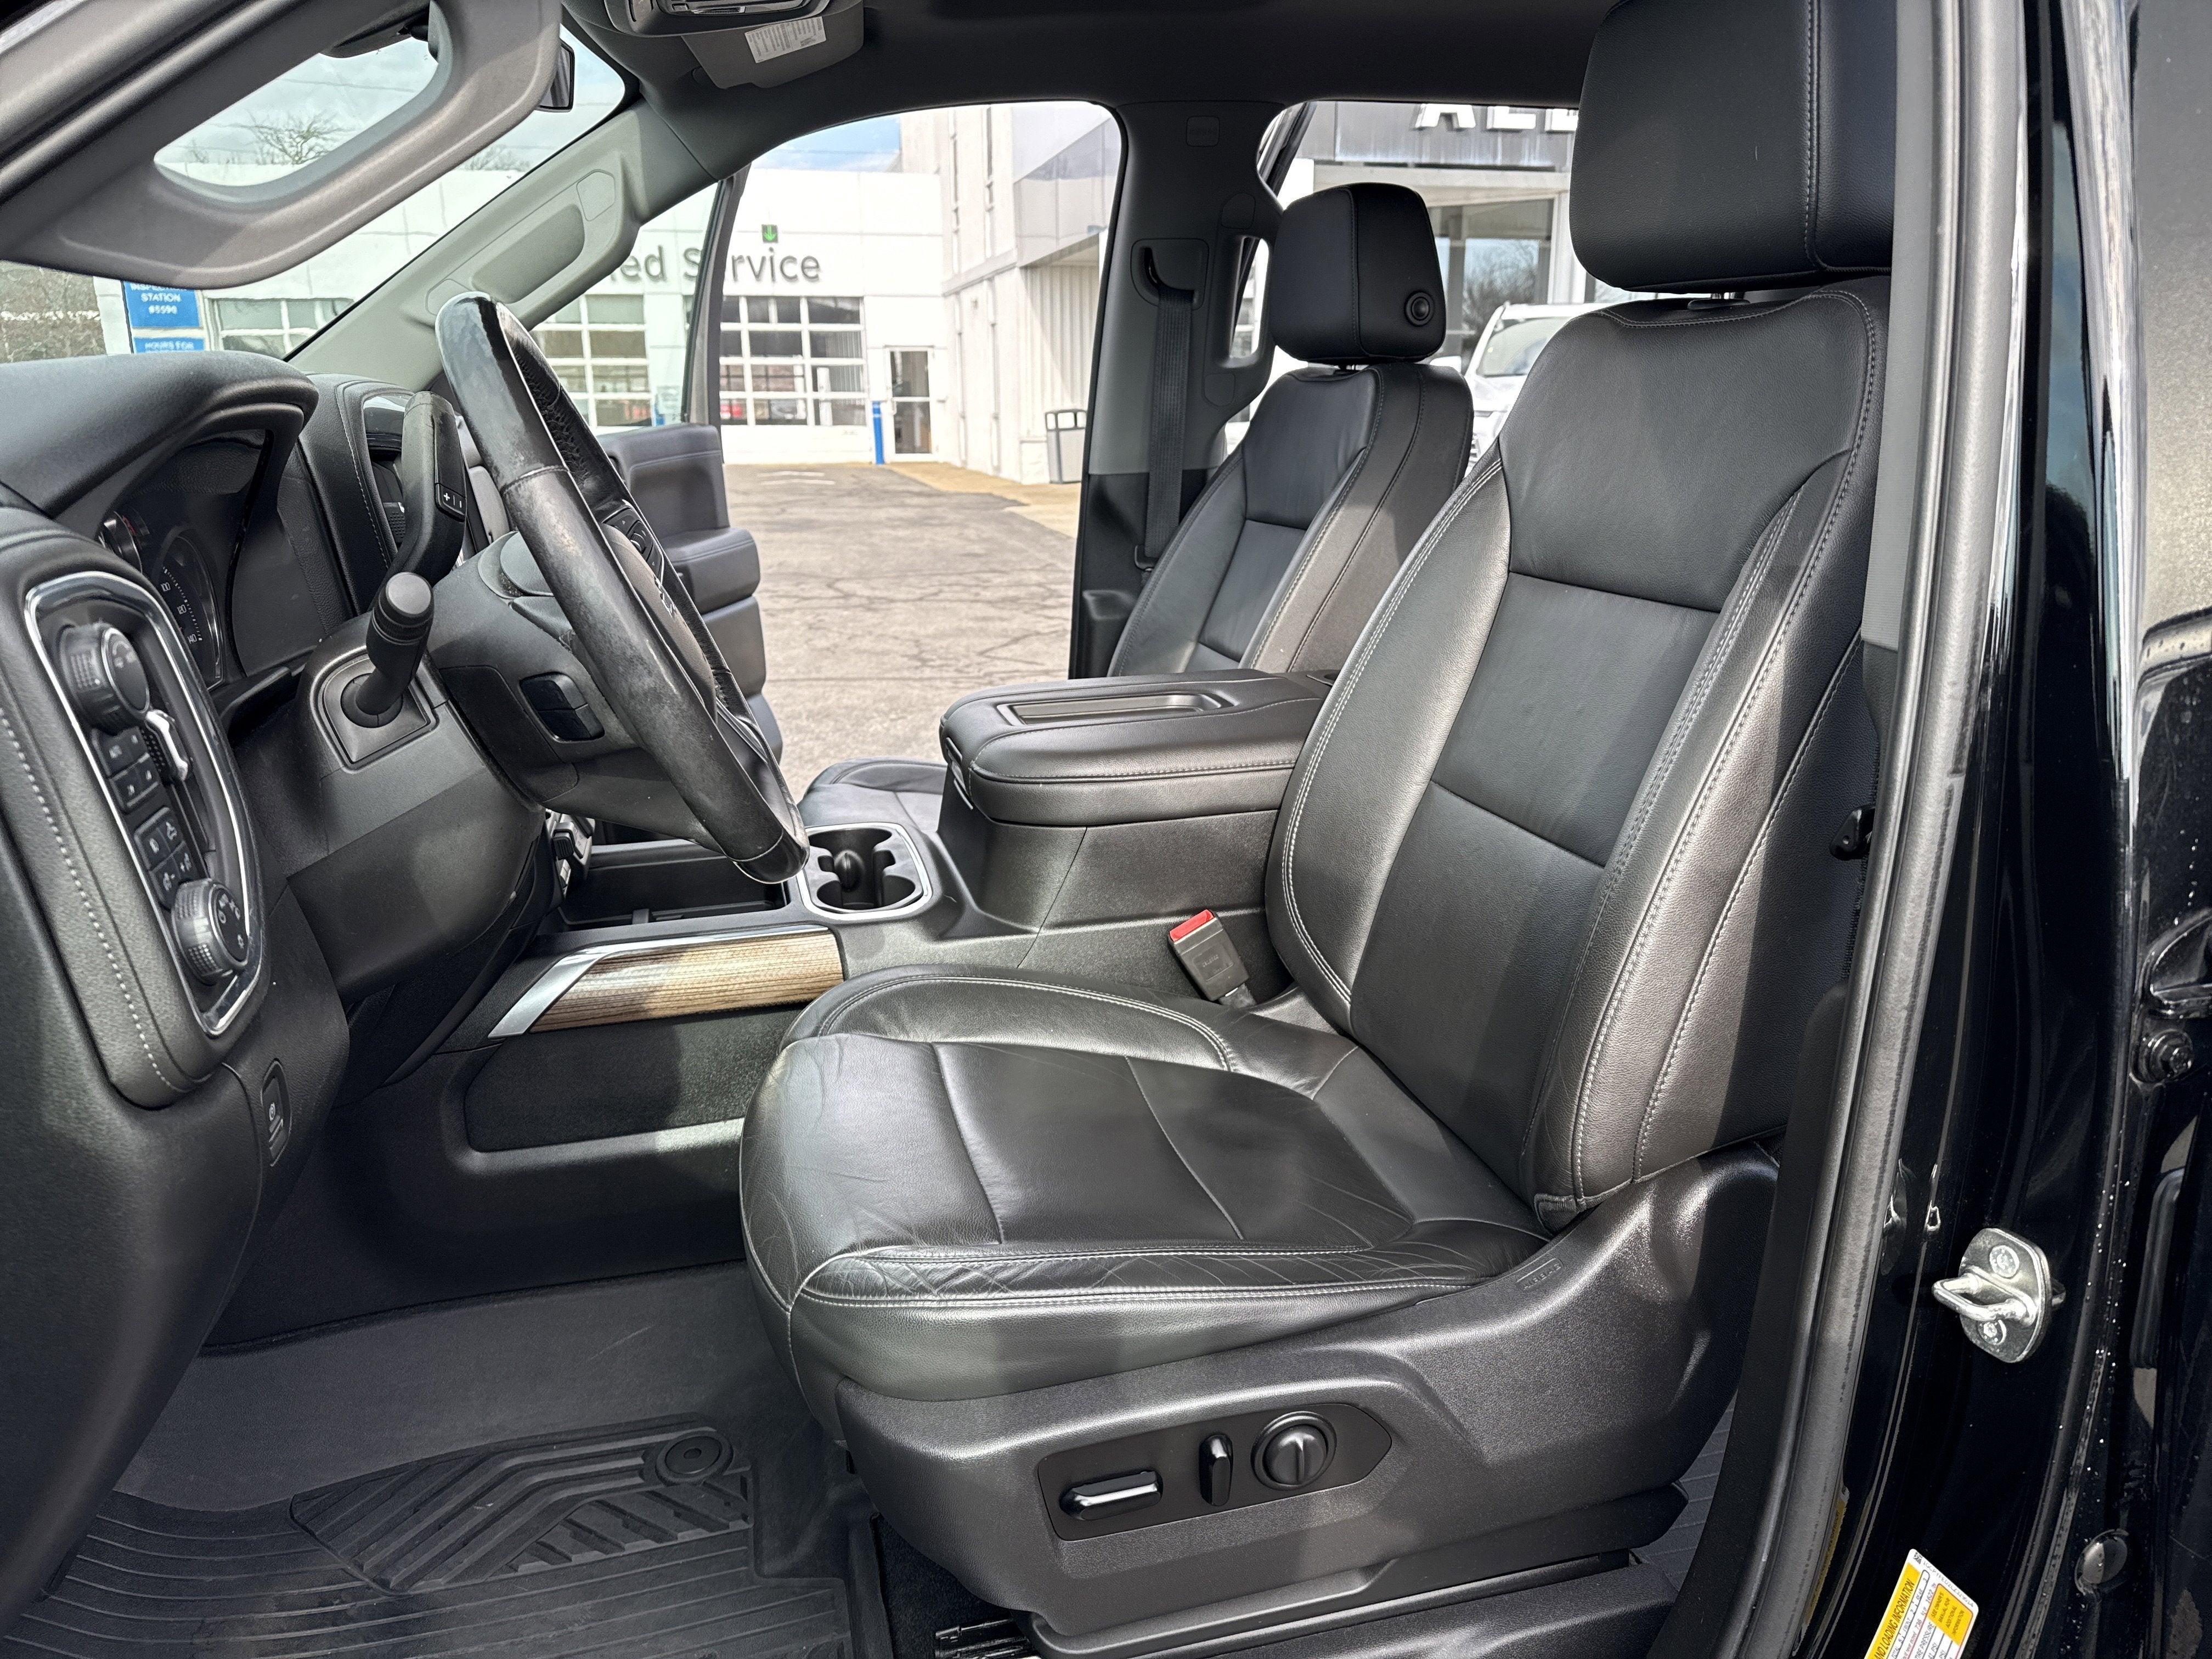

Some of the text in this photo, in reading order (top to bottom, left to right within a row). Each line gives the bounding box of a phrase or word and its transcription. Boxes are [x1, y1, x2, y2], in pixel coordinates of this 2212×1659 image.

[684, 246, 821, 283] Srvice
[140, 292, 181, 302] STATION
[187, 634, 198, 645] 140
[1880, 1619, 1899, 1650] LOADING
[1892, 1578, 1915, 1623] INFORMATION
[1920, 1622, 1935, 1650] PRESSURE
